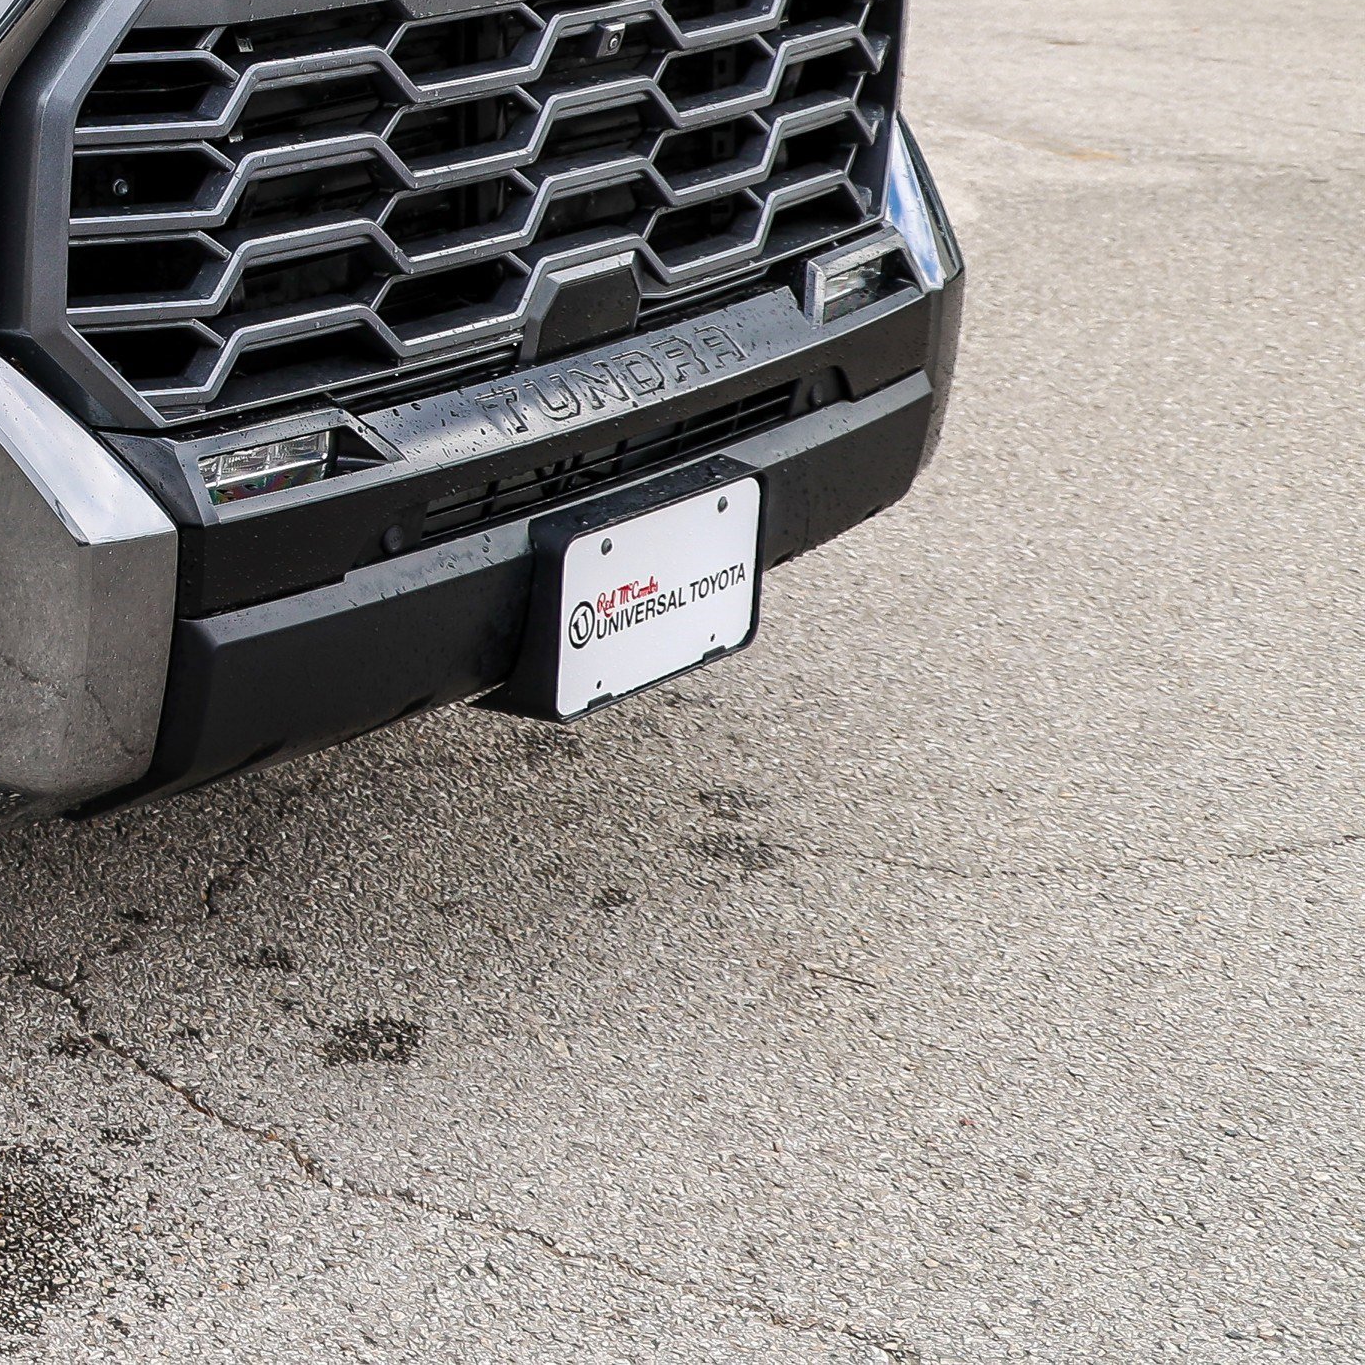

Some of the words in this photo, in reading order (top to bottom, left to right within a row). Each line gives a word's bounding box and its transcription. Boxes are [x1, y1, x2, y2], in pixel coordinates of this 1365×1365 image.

[474, 325, 749, 435] TUNDRA
[596, 587, 687, 640] UNIVERSAL
[689, 562, 746, 603] TOYOTA
[596, 590, 616, 618] Red
